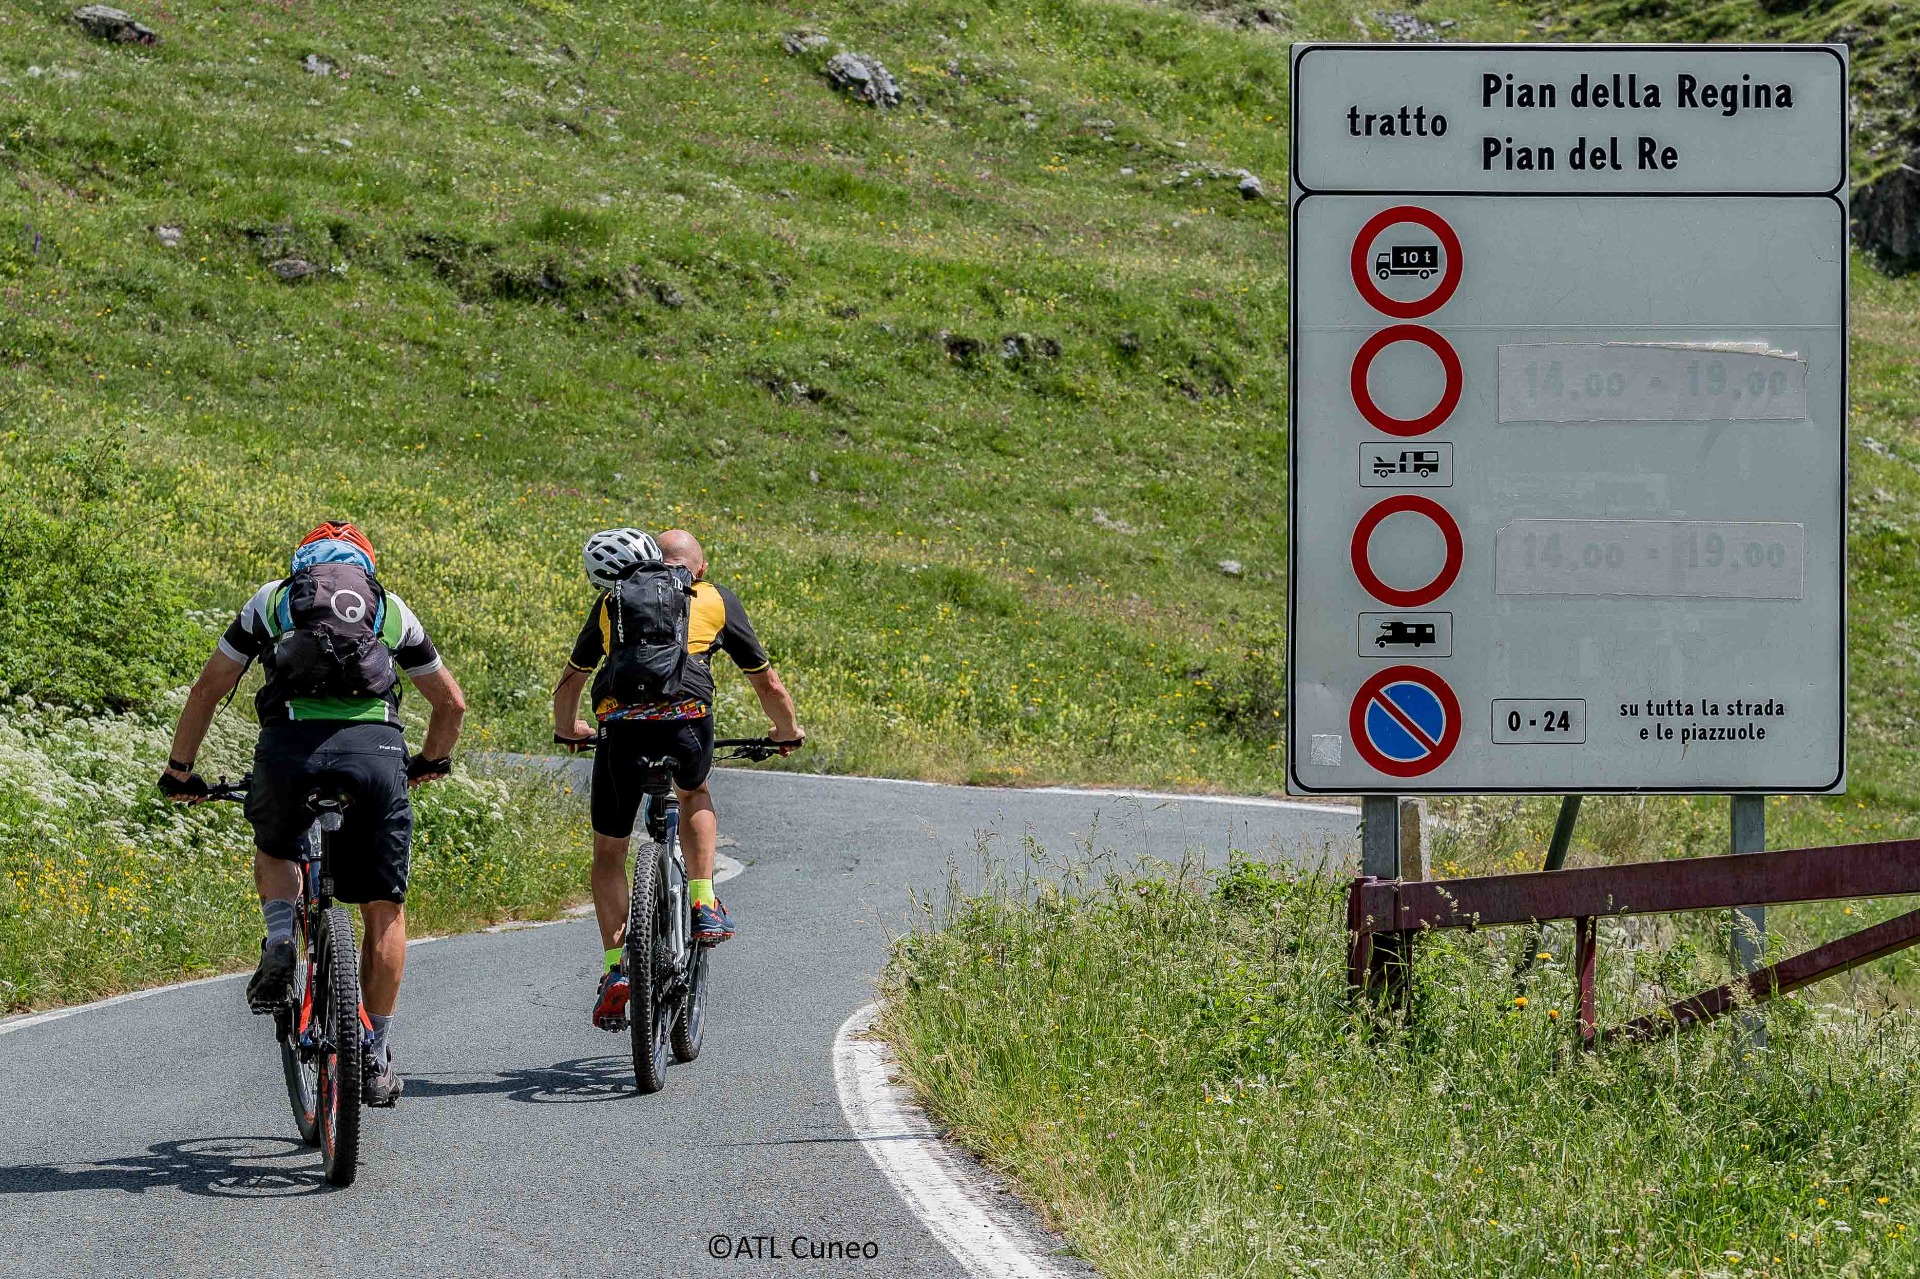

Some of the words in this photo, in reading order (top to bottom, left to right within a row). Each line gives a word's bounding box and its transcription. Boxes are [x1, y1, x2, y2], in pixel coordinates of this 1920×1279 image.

[1483, 73, 1556, 108] Pian
[1570, 73, 1662, 109] della
[1677, 73, 1794, 117] Regina
[1347, 105, 1448, 137] tratto
[1483, 136, 1555, 171] Pian
[1569, 136, 1623, 171] del
[1637, 136, 1679, 171] Re
[1399, 251, 1419, 264] 10
[1423, 250, 1431, 264] t
[1619, 703, 1639, 717] su
[1645, 698, 1695, 717] tutta
[1701, 698, 1720, 717] la
[1726, 698, 1786, 717] strada
[1507, 710, 1522, 732] 0
[1542, 710, 1571, 732] 24
[1638, 727, 1650, 741] e
[1656, 722, 1674, 741] le
[1680, 722, 1766, 746] piazzuole
